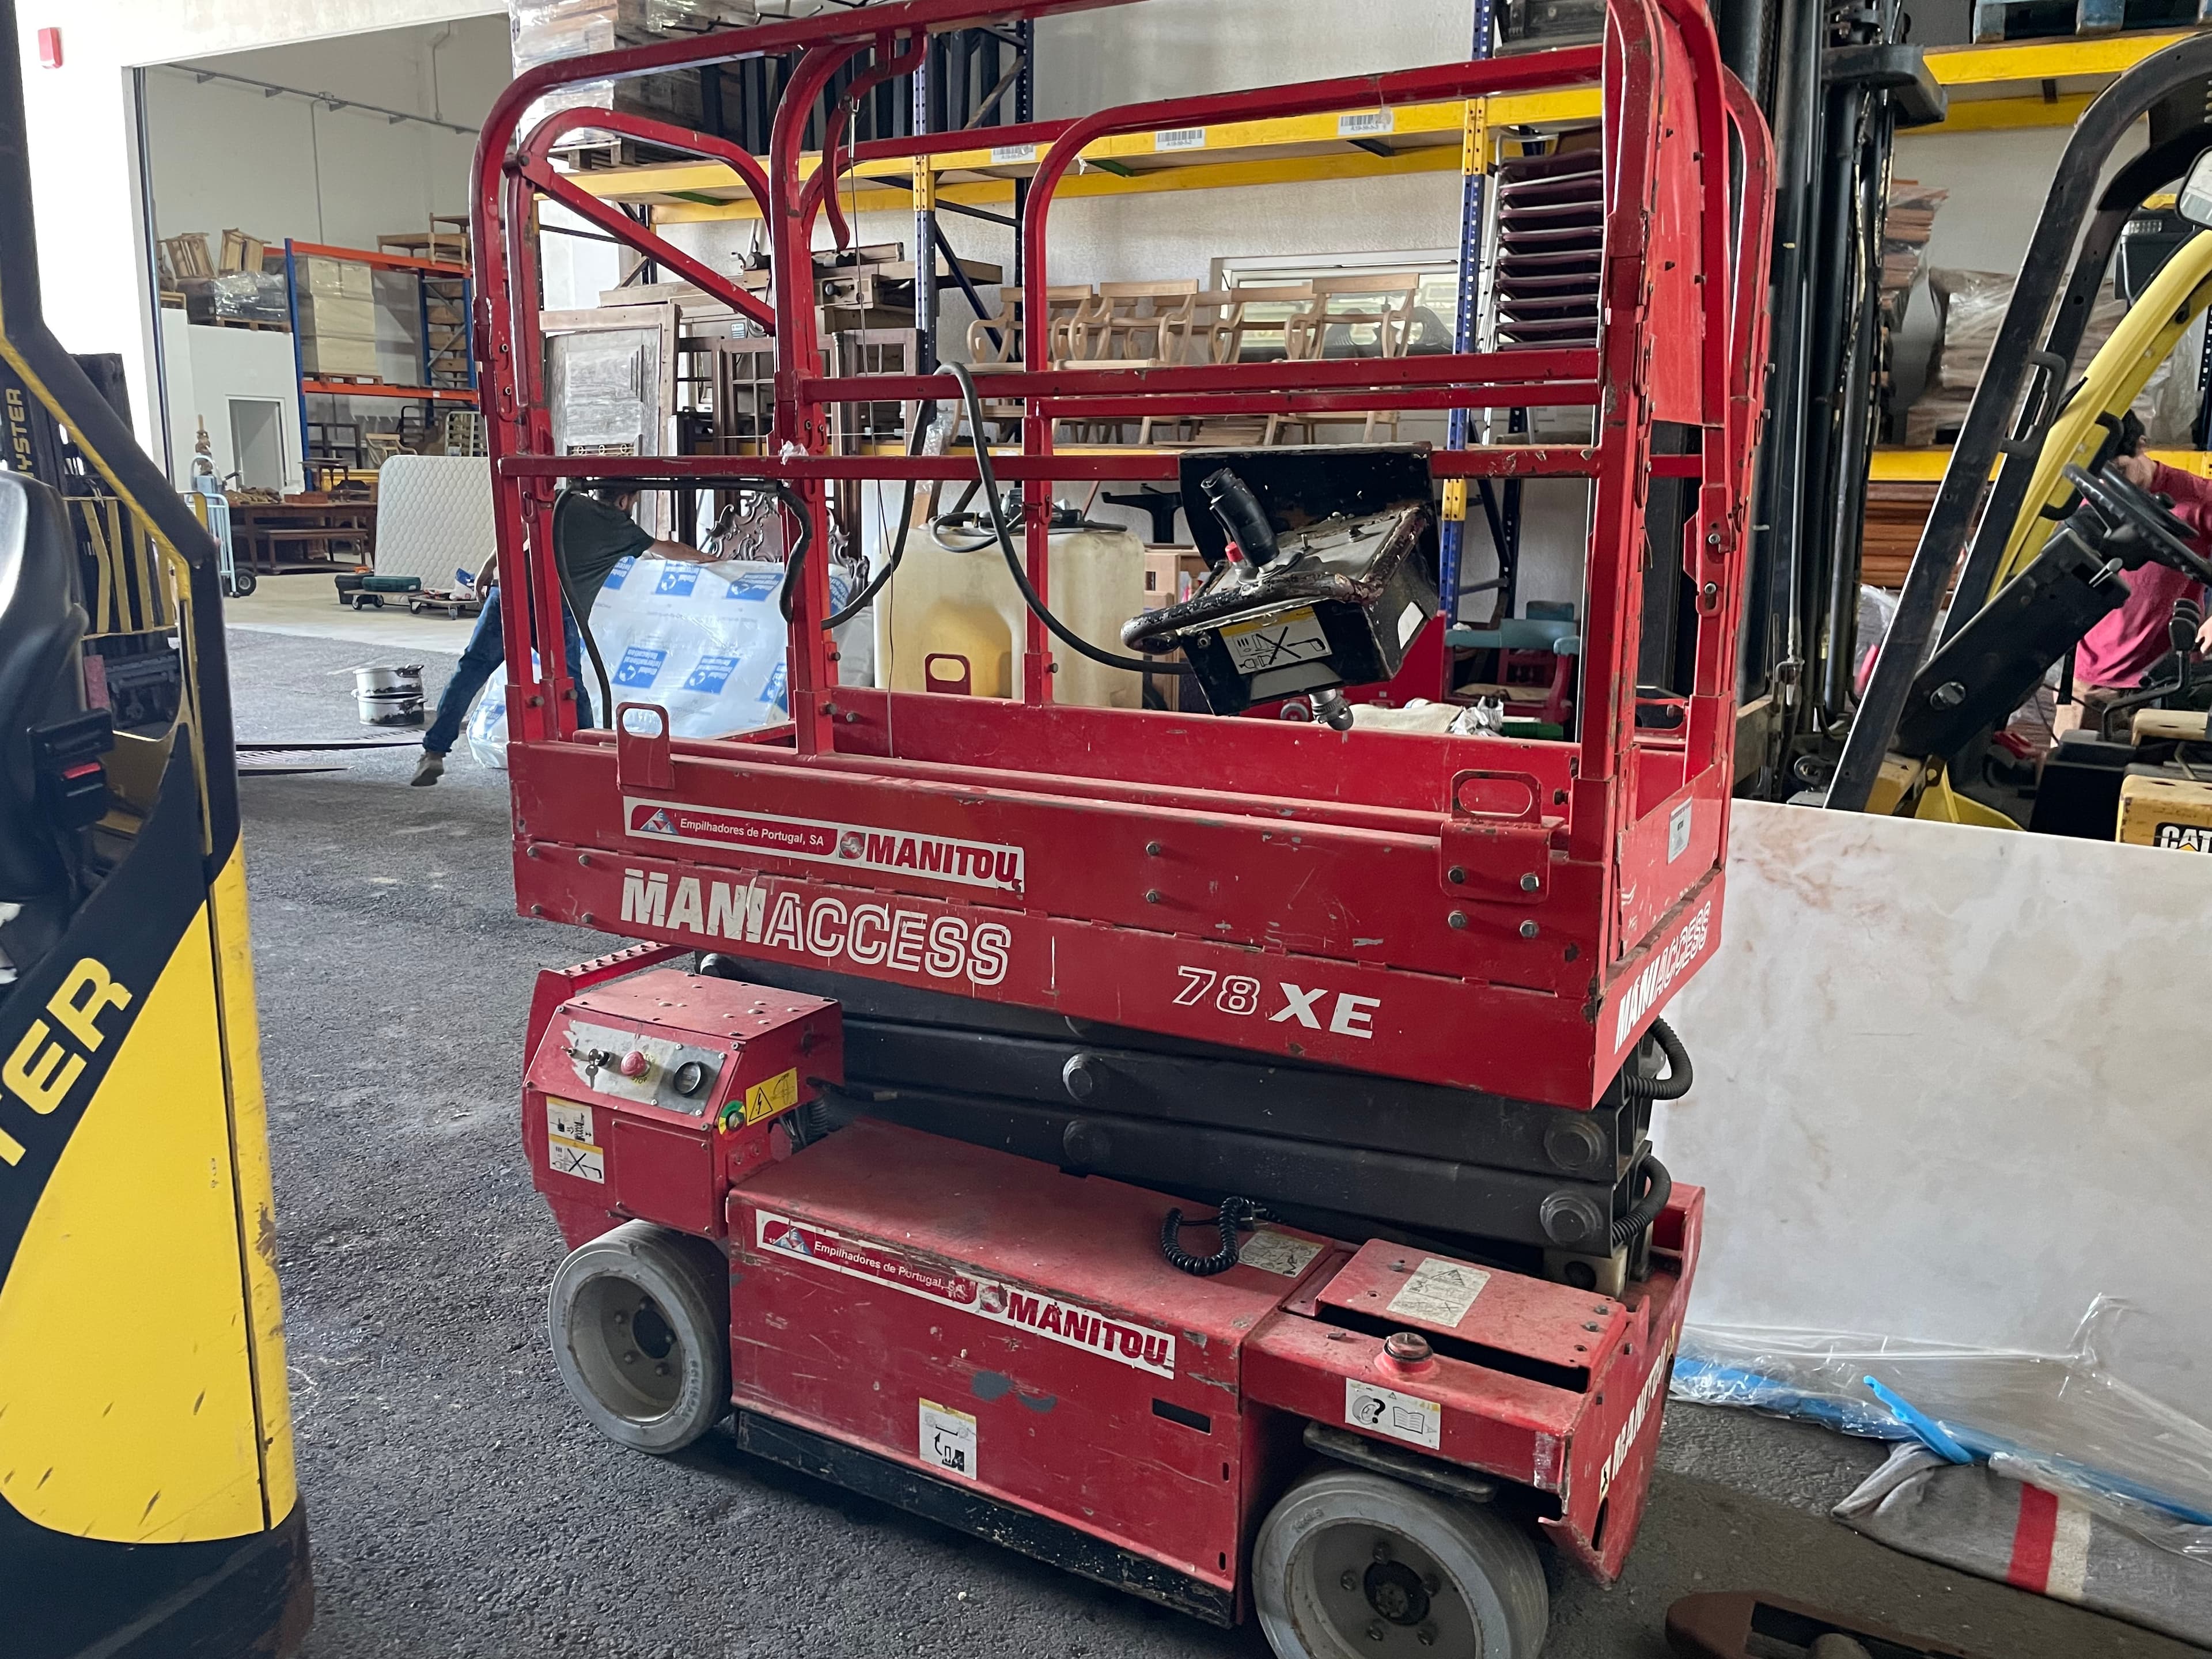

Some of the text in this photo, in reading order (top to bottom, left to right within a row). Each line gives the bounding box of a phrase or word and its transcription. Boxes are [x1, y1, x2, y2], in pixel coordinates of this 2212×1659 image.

[680, 818, 824, 846] Empilhadores de Portugal, SA
[866, 833, 1018, 882] MANITOU
[2160, 825, 2212, 853] CAT
[620, 867, 1012, 987] MANIACCESS
[1172, 965, 1381, 1039] 78 XE
[1613, 900, 1711, 1055] MANIACCESS
[814, 1240, 881, 1270] Empilhadores
[883, 1262, 896, 1274] de
[1007, 1291, 1169, 1366] MANITOU
